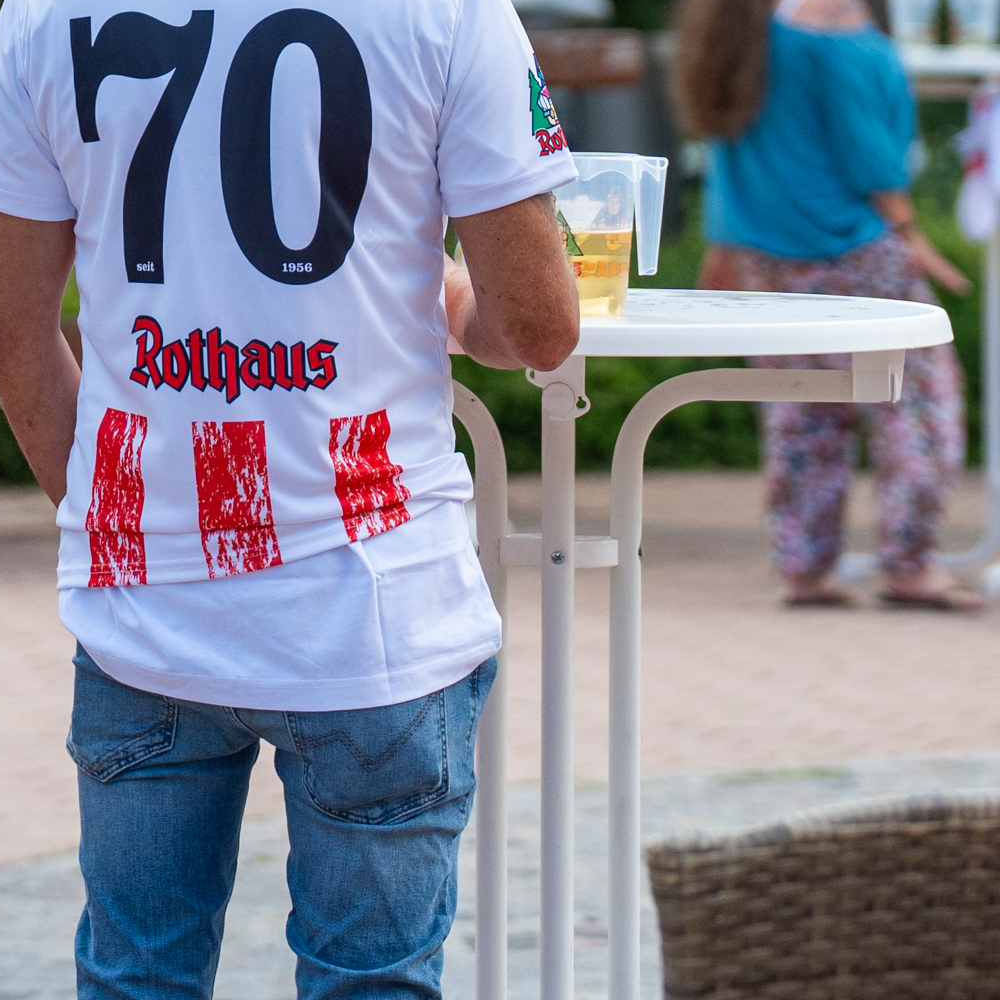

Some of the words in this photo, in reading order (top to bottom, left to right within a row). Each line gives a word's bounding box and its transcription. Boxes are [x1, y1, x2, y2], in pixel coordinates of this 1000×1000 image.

[68, 7, 373, 286] 70
[136, 261, 155, 272] seit
[282, 262, 313, 273] 1956
[129, 314, 339, 404] Rothaus
